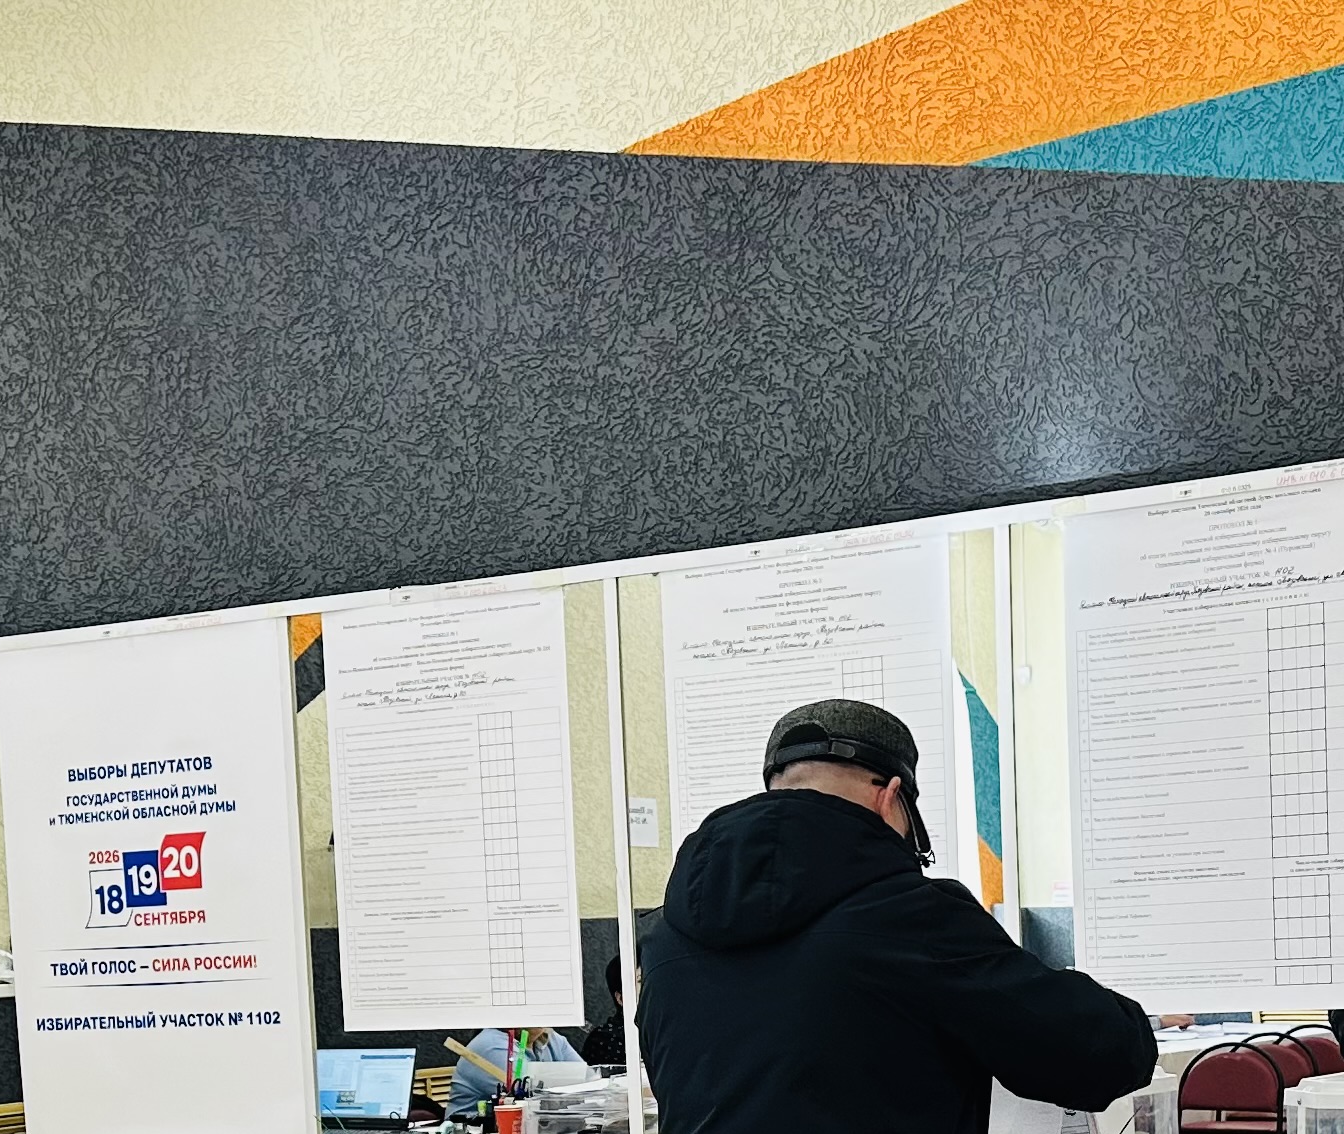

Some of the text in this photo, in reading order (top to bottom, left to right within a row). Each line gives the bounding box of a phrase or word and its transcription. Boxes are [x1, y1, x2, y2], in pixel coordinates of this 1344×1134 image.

[68, 756, 212, 782] ВЫБОРЫ ДЕПУТАТОВ
[66, 784, 217, 807] ГОСУДАРСТВЕННОЙ ДУМЫ
[58, 806, 129, 826] ТЮМЕНСКОЙ
[132, 800, 197, 819] ОБЛАСНОЙ
[199, 800, 236, 816] ДУМЫ
[88, 850, 120, 865] 2026
[95, 845, 199, 915] 18 19 20
[134, 910, 206, 926] СЕНТЯБРЯ
[50, 958, 88, 977] ТВОЙ
[92, 960, 136, 975] ГОЛОС
[152, 957, 191, 972] СИЛА
[194, 954, 257, 971] РОССИИ!
[36, 1011, 281, 1032] ИЗБИРАТЕЛЬНЫЙ УЧАСТОК № 1102
